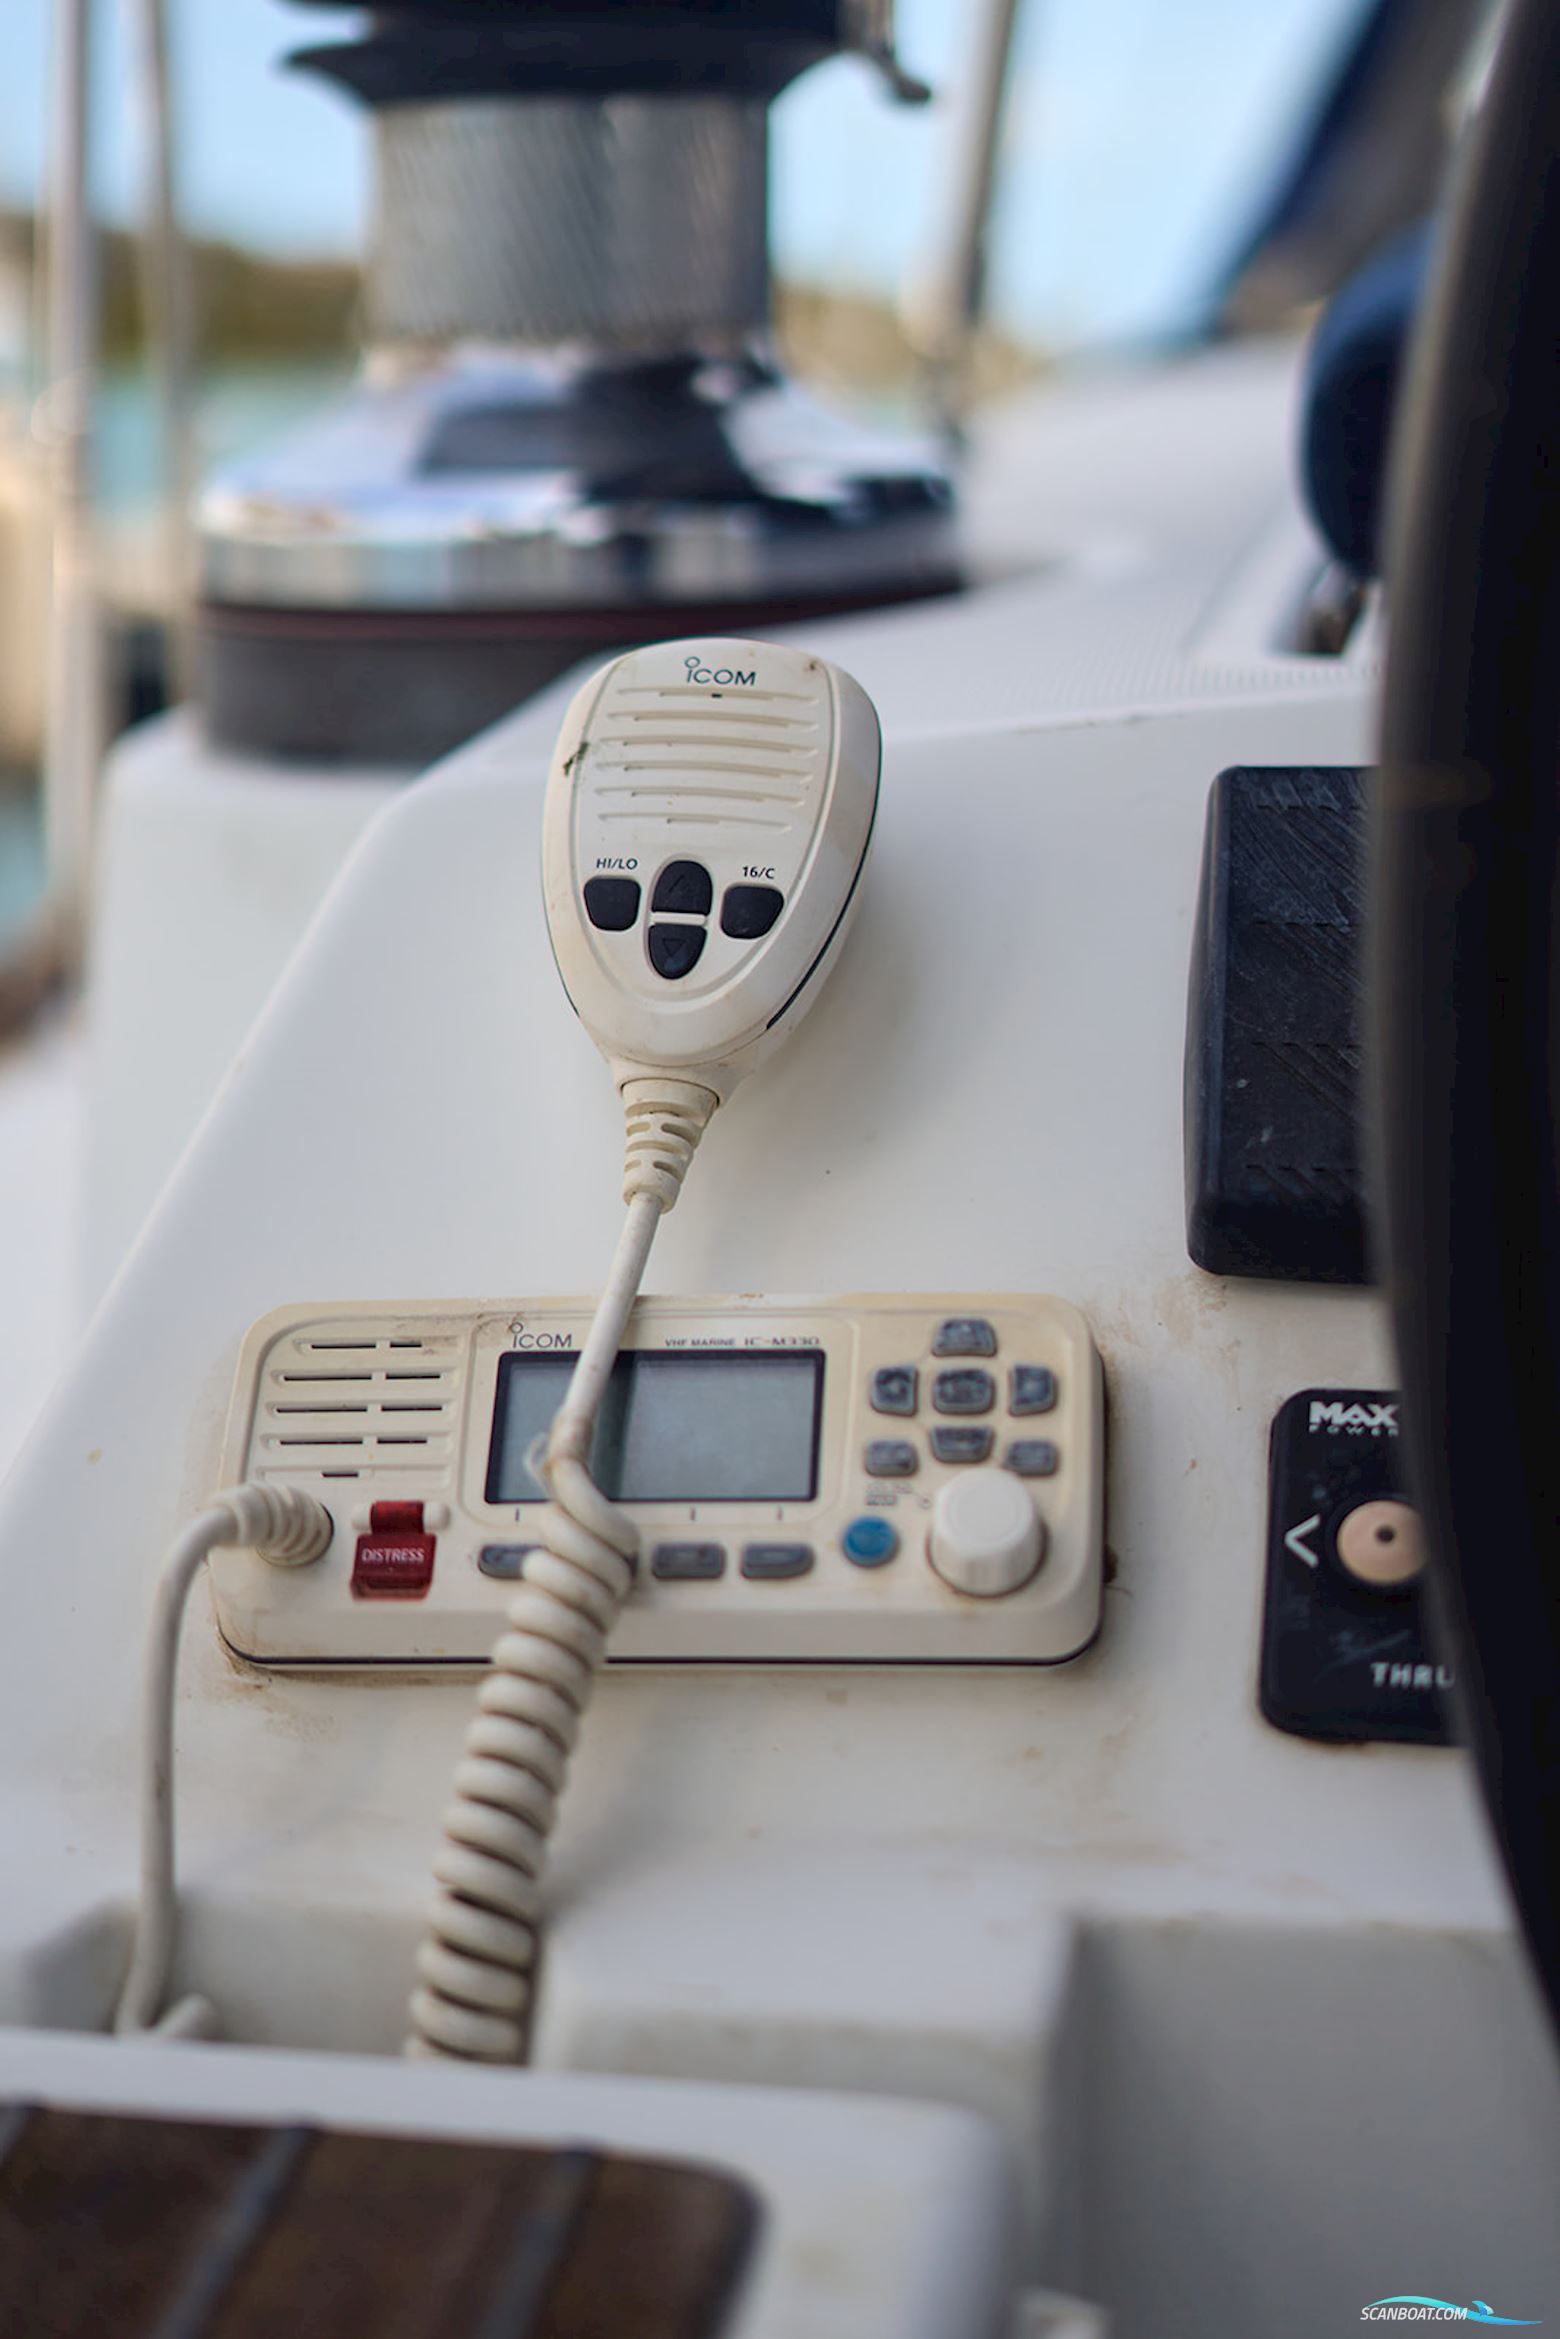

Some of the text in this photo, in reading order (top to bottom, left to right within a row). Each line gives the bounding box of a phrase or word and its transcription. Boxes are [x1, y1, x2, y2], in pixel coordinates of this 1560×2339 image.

[595, 857, 638, 870] HI/LO
[742, 865, 776, 880] 16/C
[690, 1337, 736, 1347] MARINE
[1309, 1400, 1399, 1427] MAX
[361, 1547, 426, 1564] DISTRESS
